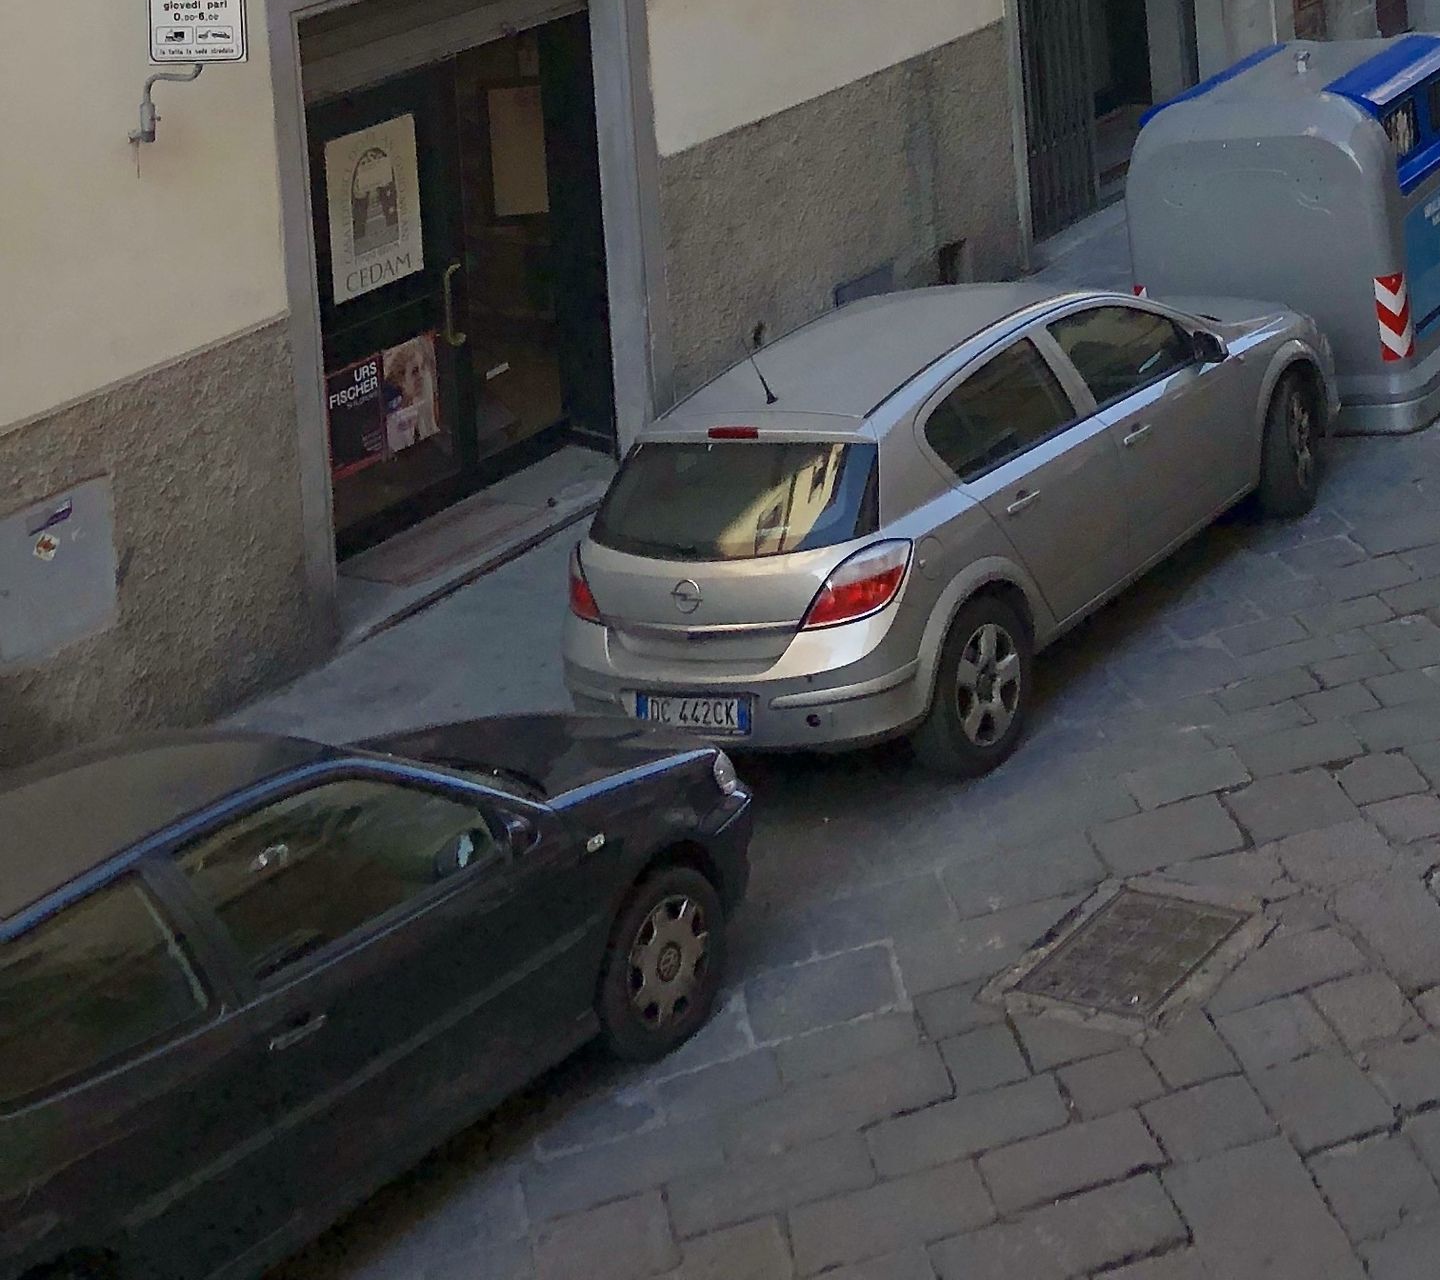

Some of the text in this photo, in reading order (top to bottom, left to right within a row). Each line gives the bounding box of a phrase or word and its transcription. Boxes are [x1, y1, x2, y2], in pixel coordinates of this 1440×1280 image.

[207, 0, 228, 9] pari
[346, 252, 412, 292] CEDAM
[354, 361, 377, 382] URS
[329, 376, 378, 410] FISCHER
[679, 701, 734, 725] 442CK
